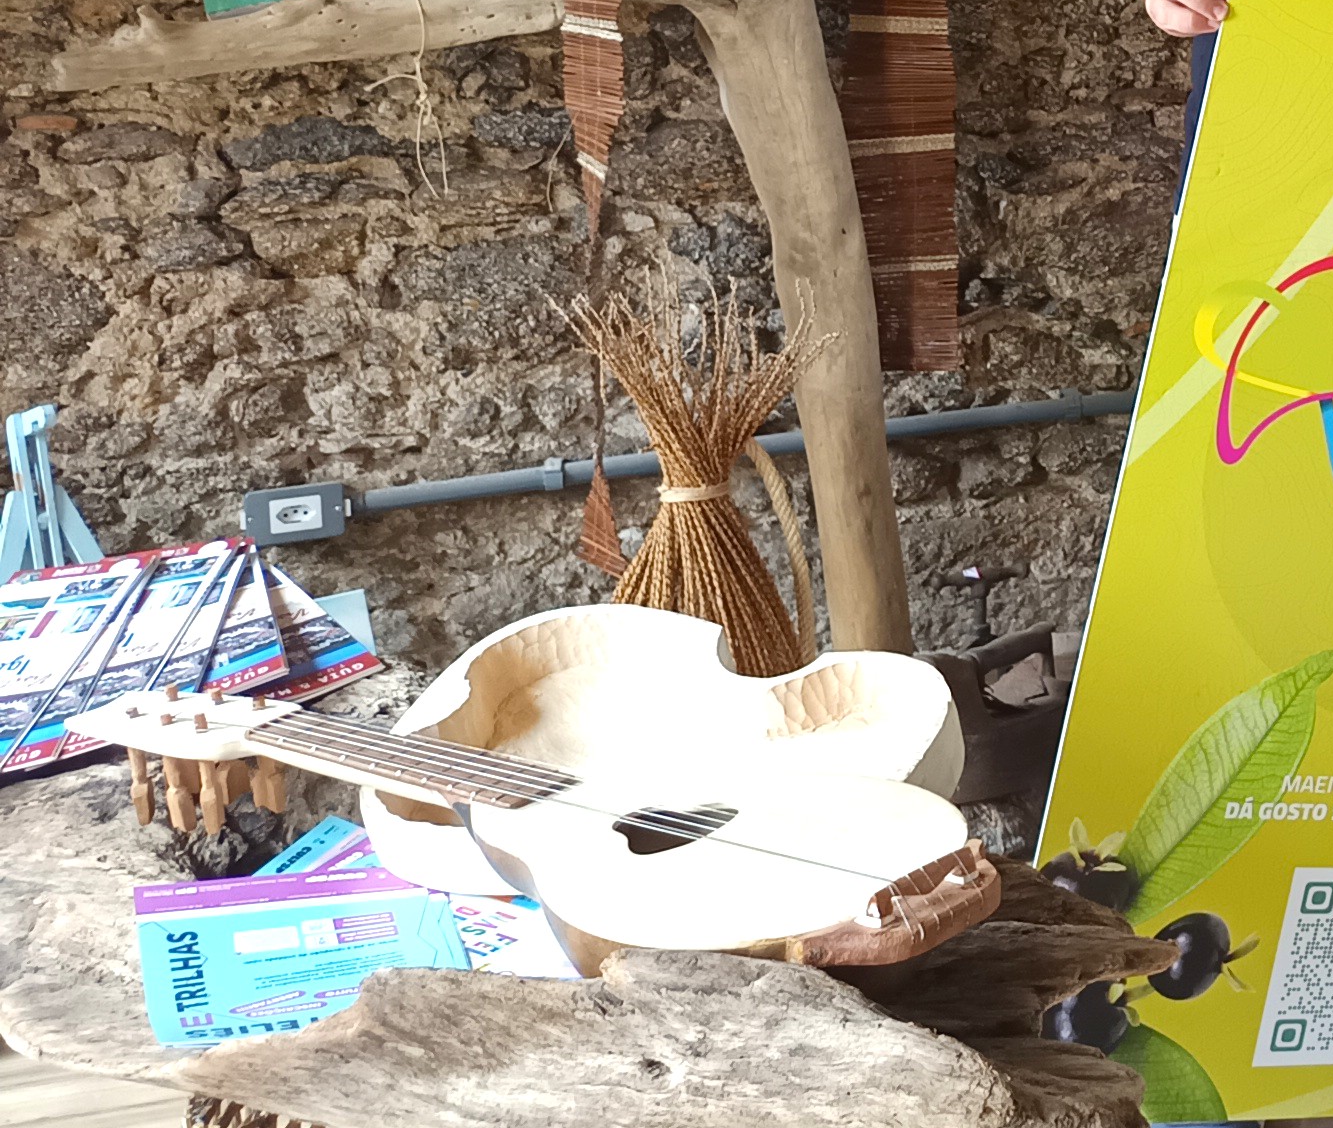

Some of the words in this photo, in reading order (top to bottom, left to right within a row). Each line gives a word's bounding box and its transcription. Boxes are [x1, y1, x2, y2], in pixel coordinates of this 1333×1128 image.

[1225, 797, 1253, 820] DÁ
[1259, 802, 1327, 821] GOSTO
[166, 931, 209, 1013] TRILHAS
